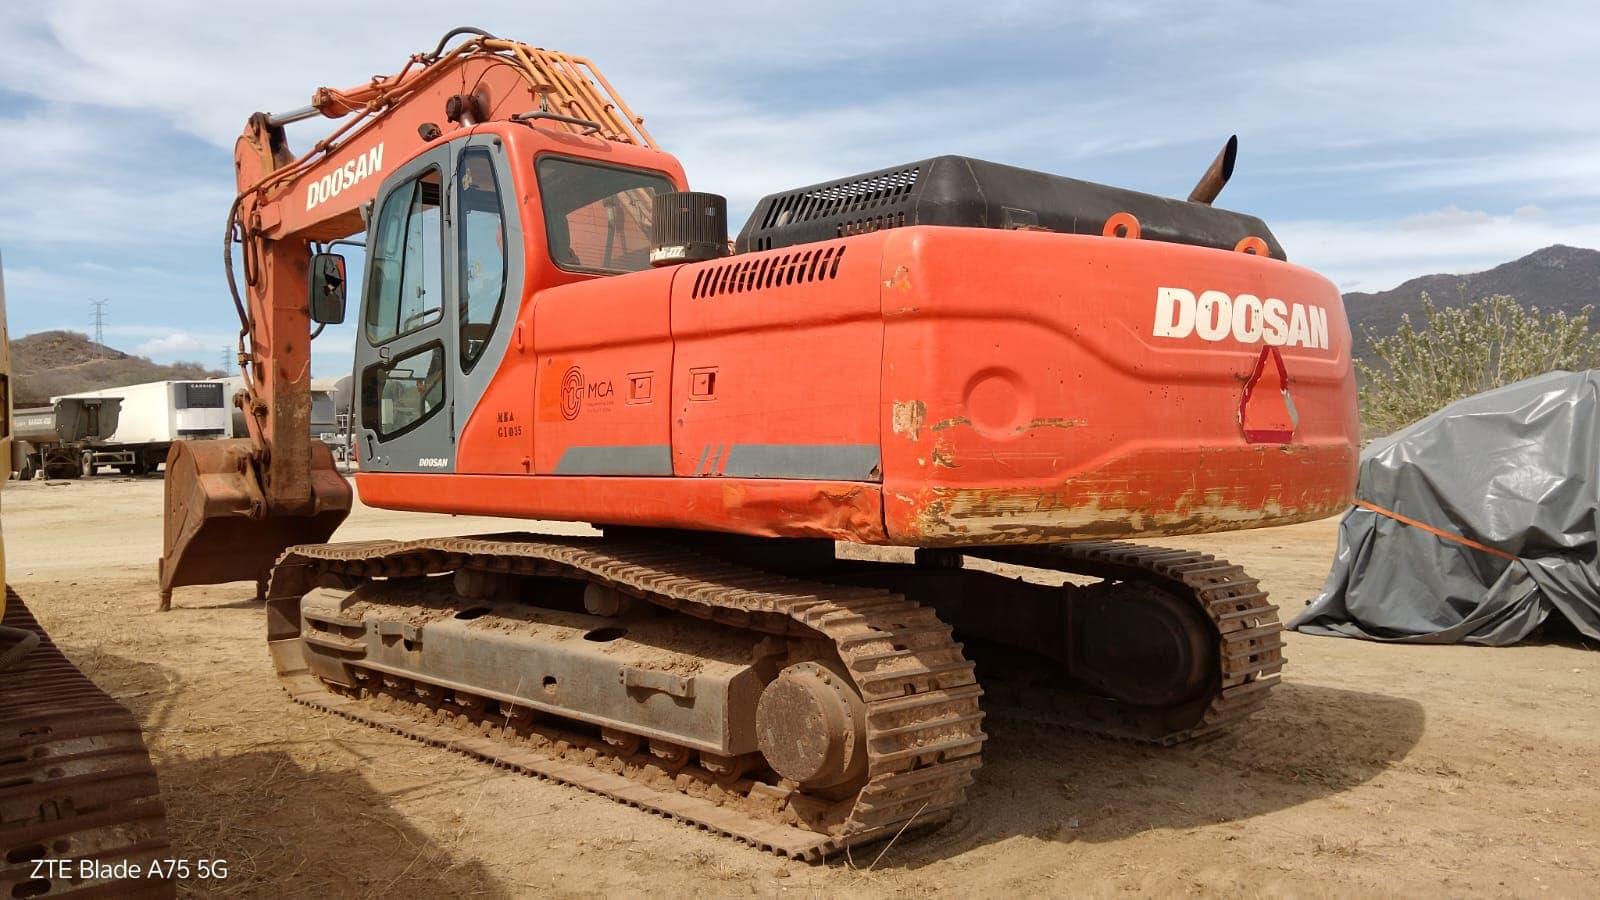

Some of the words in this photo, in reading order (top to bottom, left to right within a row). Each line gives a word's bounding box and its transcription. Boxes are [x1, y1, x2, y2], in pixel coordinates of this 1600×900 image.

[306, 142, 384, 212] DOOSAN
[1153, 287, 1328, 349] DOOSAN
[587, 380, 614, 399] MCA
[418, 458, 448, 467] DOOSAN
